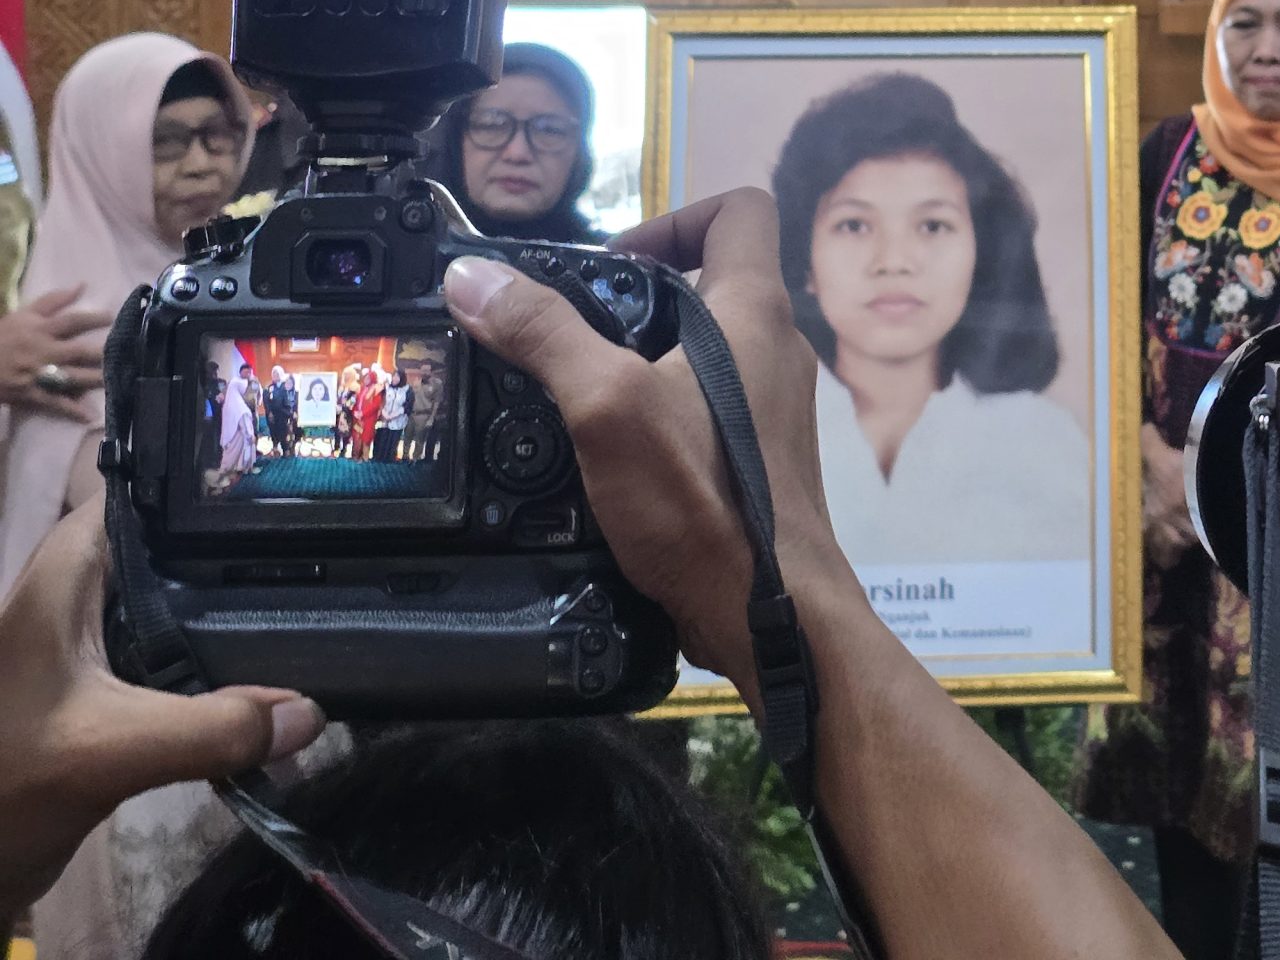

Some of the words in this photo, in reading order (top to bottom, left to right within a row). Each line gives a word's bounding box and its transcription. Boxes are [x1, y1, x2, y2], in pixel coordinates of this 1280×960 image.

[519, 249, 551, 260] AF-ON
[514, 444, 534, 456] SET
[547, 533, 576, 544] LOCK
